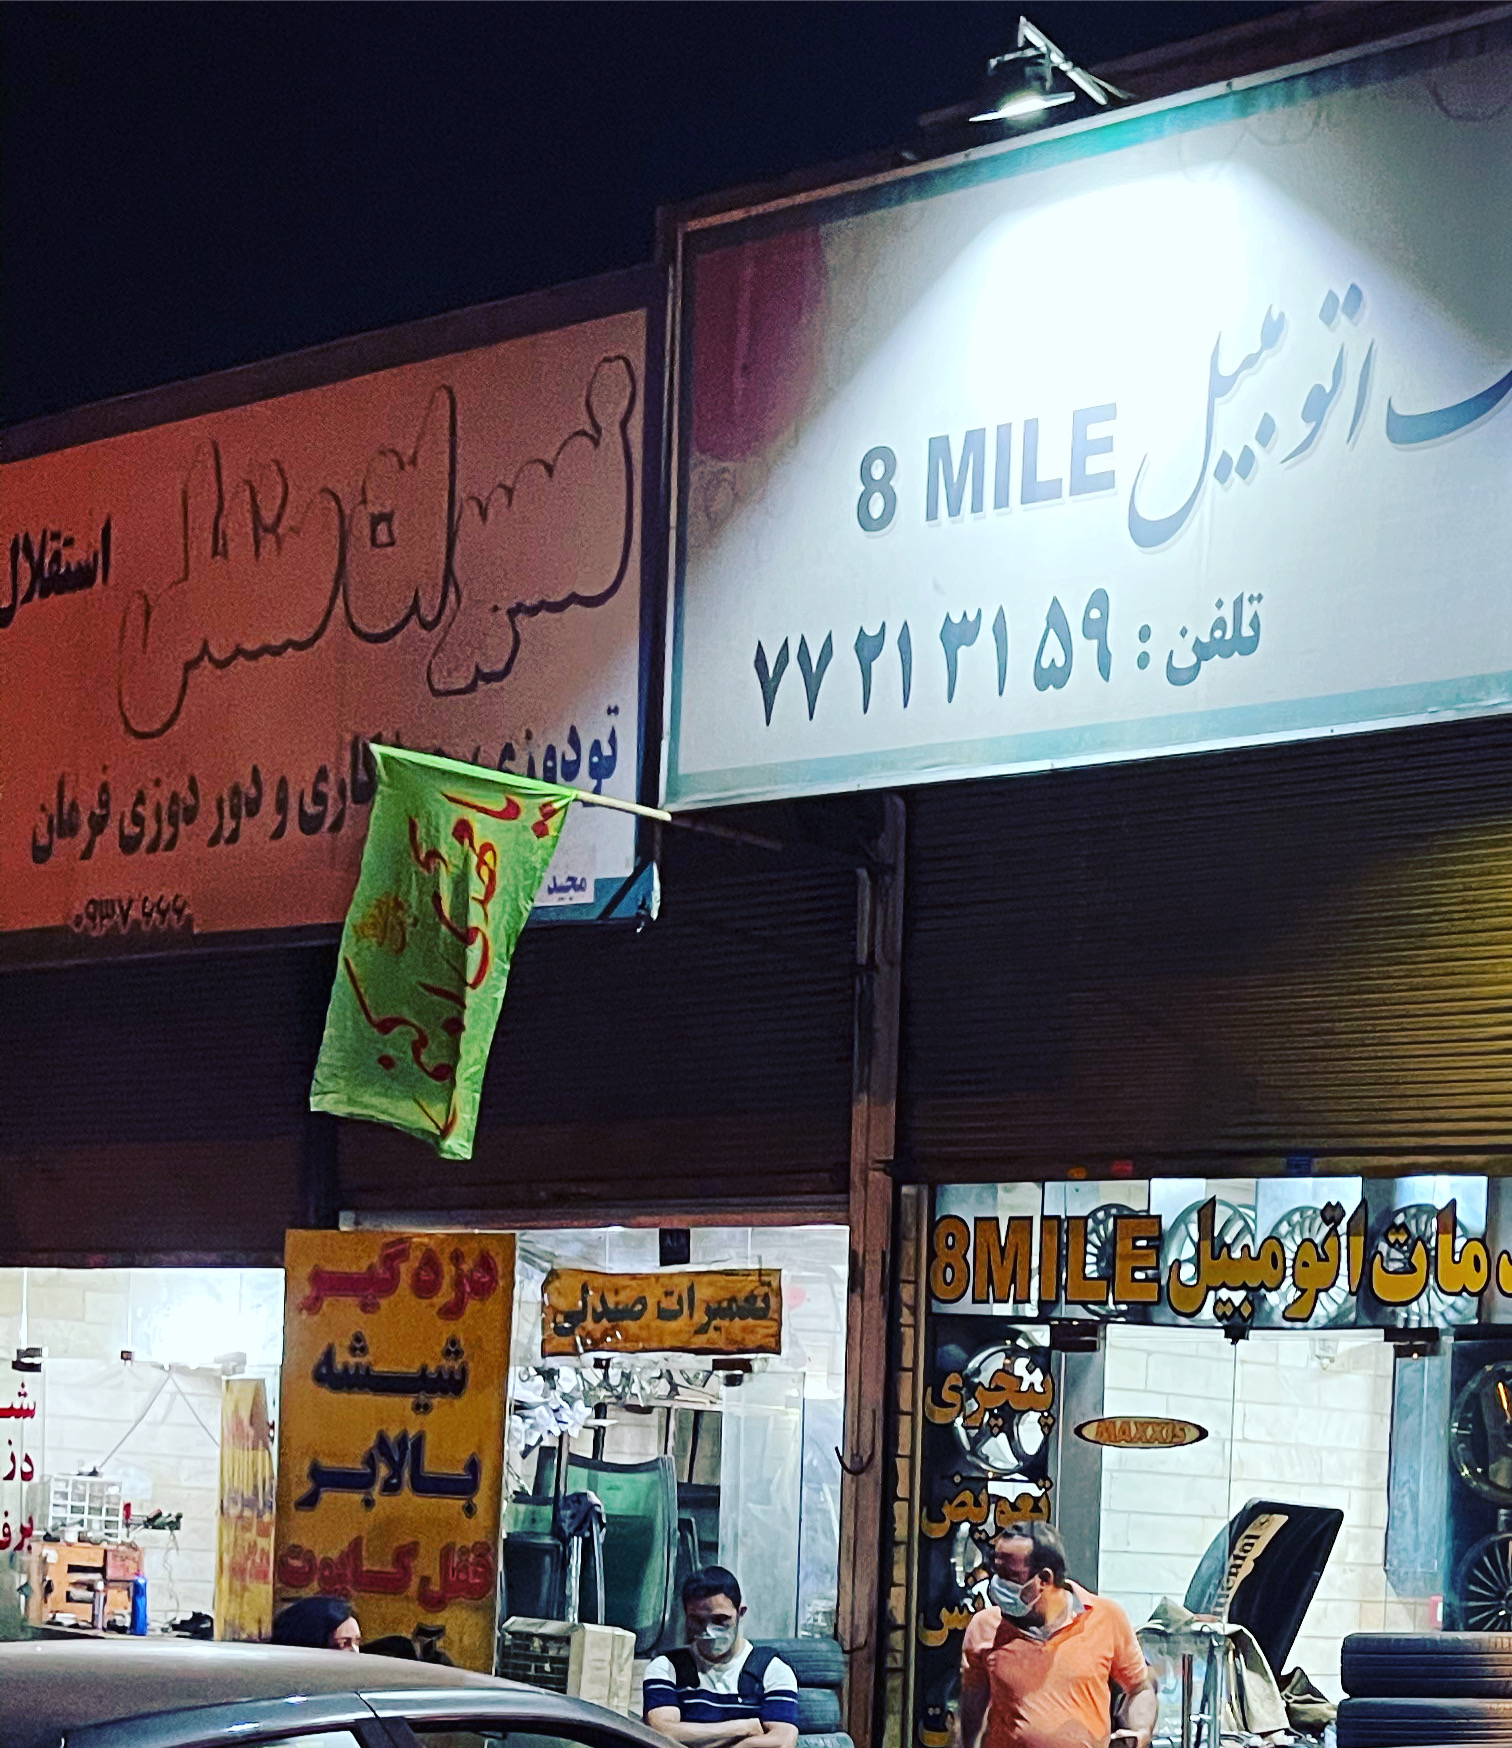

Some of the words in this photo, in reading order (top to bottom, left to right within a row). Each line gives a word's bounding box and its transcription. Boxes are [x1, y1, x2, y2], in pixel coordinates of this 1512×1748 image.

[1127, 281, 1376, 549] اتومبیل
[857, 445, 897, 532] 8
[925, 403, 1118, 524] MILE
[930, 1213, 1163, 1305] 8MILE
[1166, 1194, 1368, 1322] اتومبیل
[552, 1280, 648, 1338] صندلی
[656, 1279, 772, 1337] تعمیرات
[311, 1330, 470, 1415] شیشه
[1096, 1420, 1187, 1444] MAXXIS
[293, 1428, 481, 1520] بالابر
[920, 1473, 1053, 1547] تعویض
[277, 1535, 419, 1602] کاپوت
[417, 1540, 497, 1613] قفل
